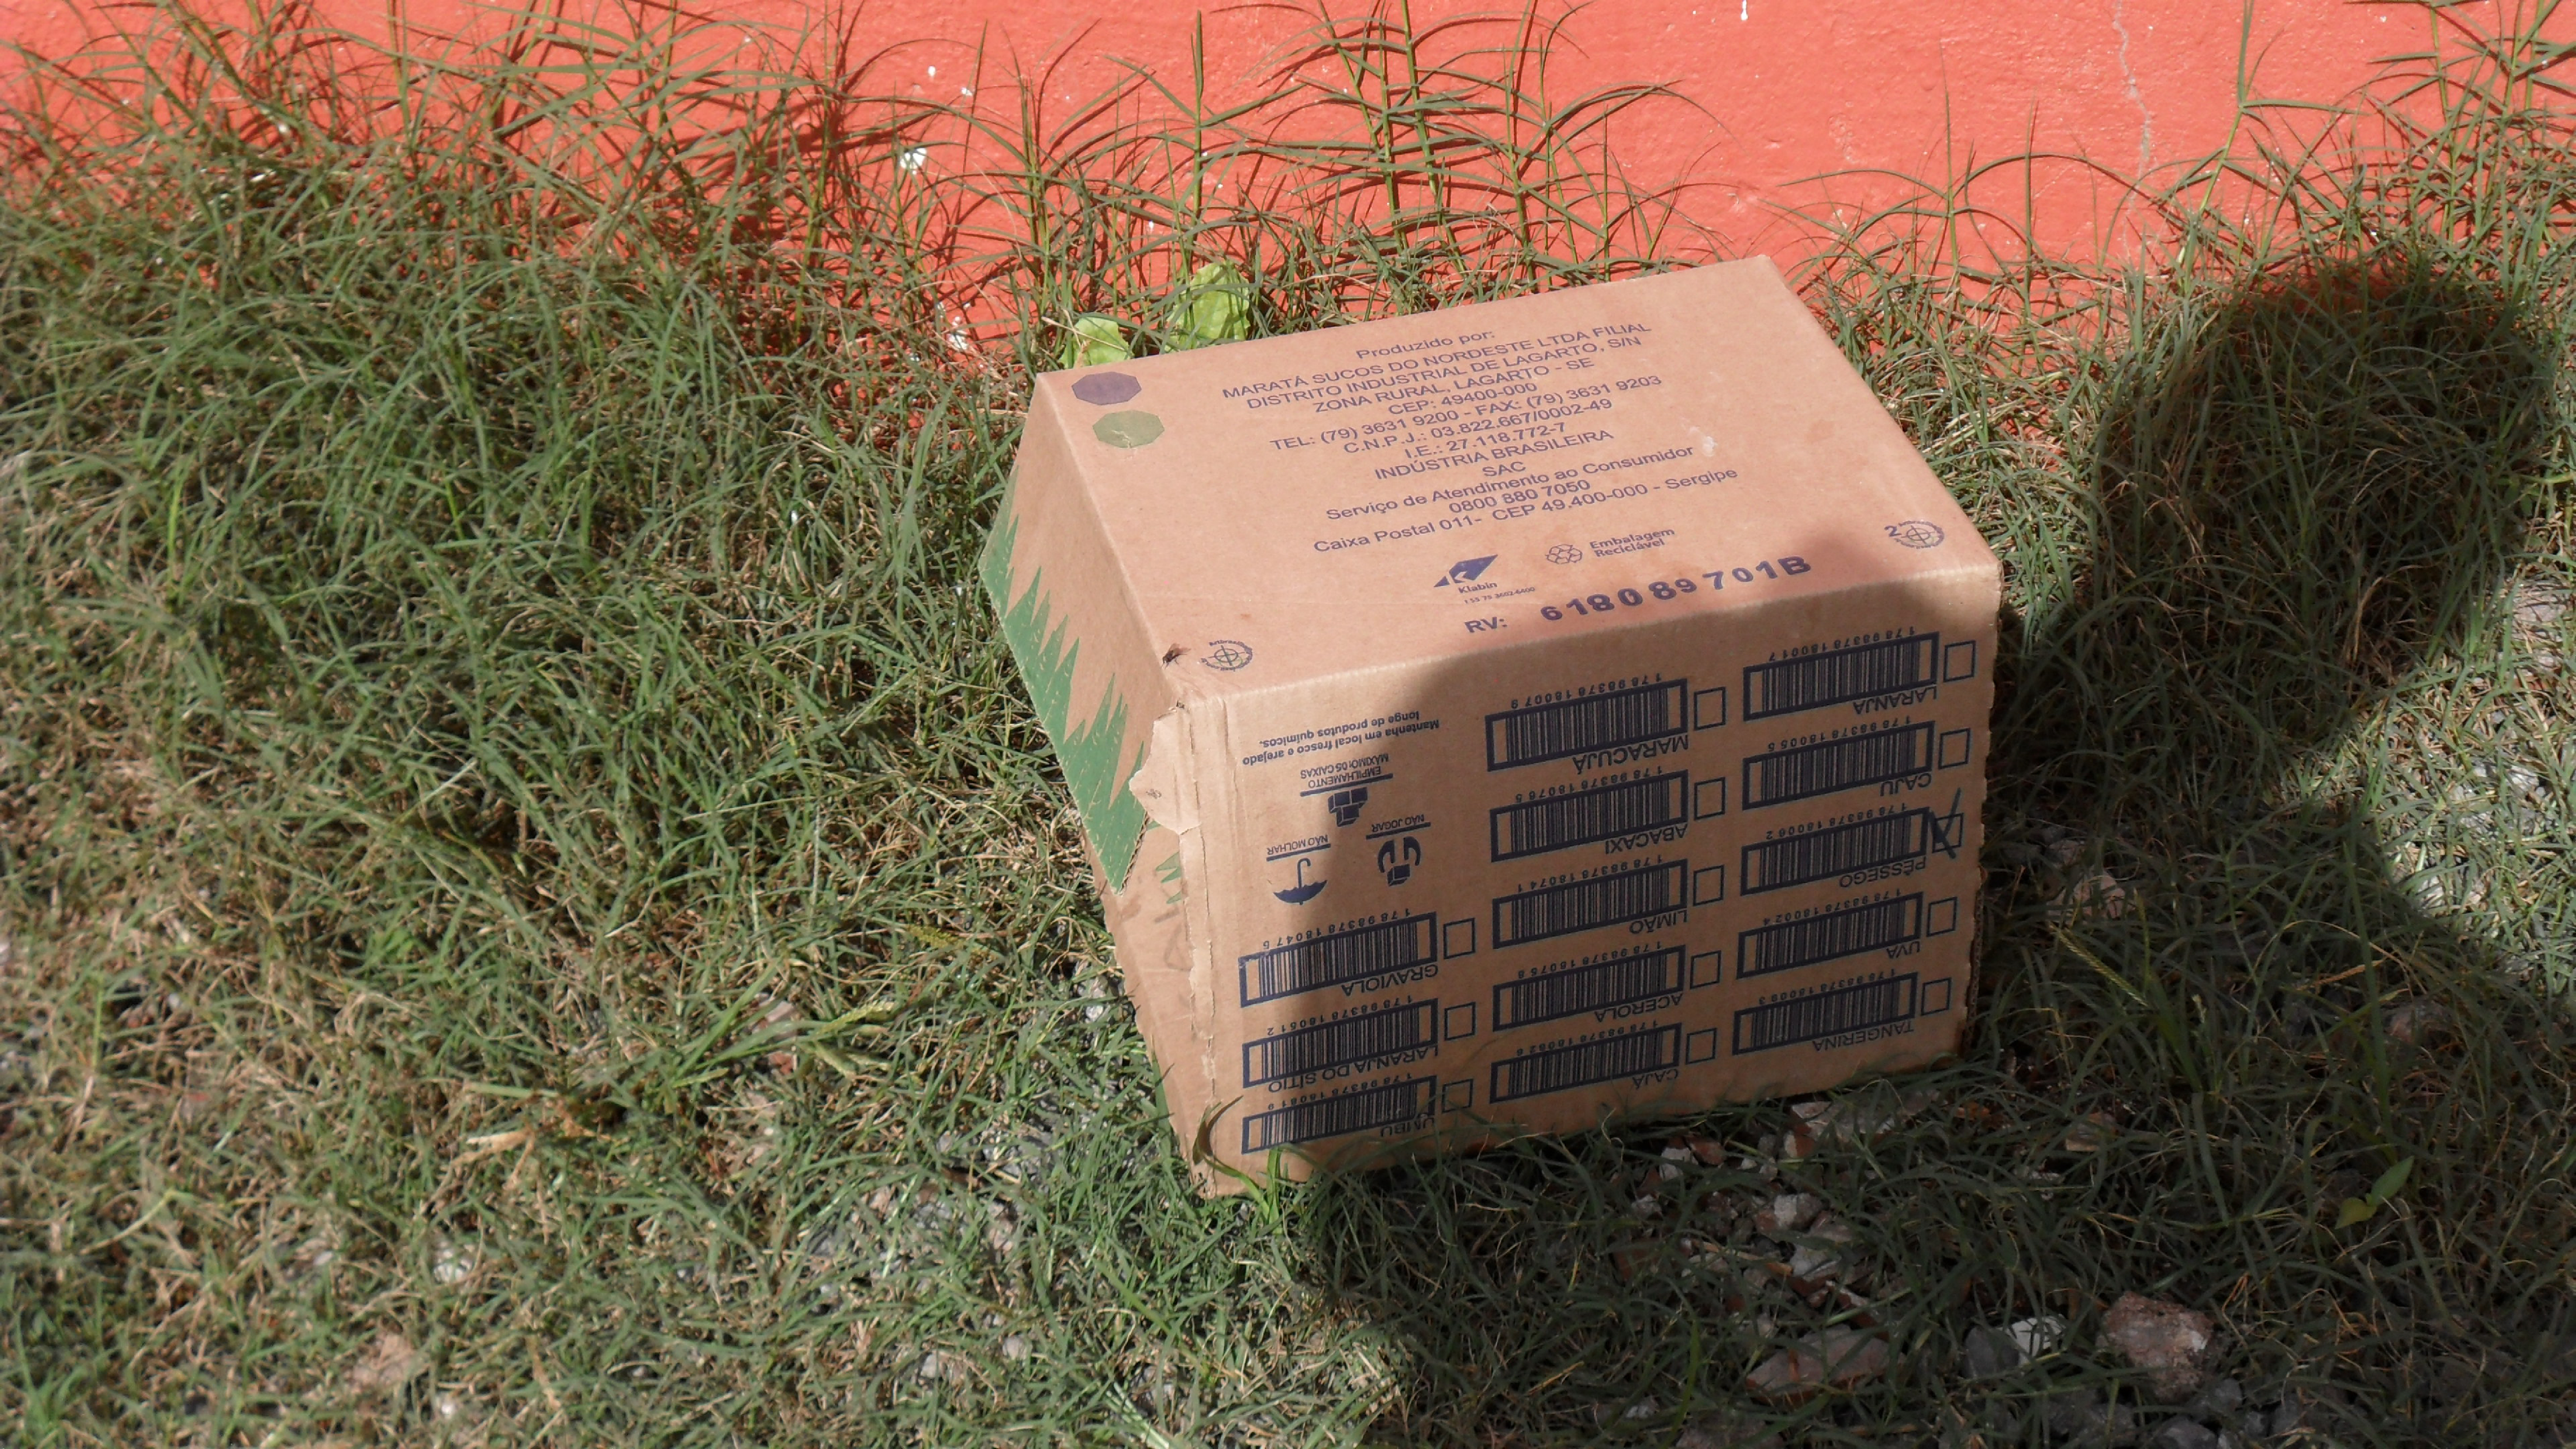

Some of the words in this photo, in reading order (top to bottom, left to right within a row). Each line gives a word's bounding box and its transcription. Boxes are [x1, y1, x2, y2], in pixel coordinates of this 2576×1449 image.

[1356, 337, 1453, 359] Produzido
[1459, 331, 1495, 345] por:
[1222, 376, 1309, 398] MARATÁ
[1312, 365, 1384, 384] SUCOS
[1389, 360, 1419, 372] DO
[1422, 340, 1534, 366] NORDESTE
[1537, 330, 1590, 348] LTDA
[1592, 323, 1652, 337] FILIAL
[1247, 386, 1341, 408] DISTRITO
[1346, 363, 1467, 393] INDUSTRIAL
[1470, 358, 1499, 372] DE
[1503, 344, 1604, 368] LAGARTO,
[1608, 337, 1642, 349] S/N
[1315, 395, 1372, 413] ZONA
[1375, 383, 1451, 403] RURAL,
[1453, 366, 1549, 389] LAGARTO
[1565, 358, 1594, 370] SE
[1388, 400, 1436, 415] CEP:
[1441, 383, 1537, 405] 49400-000
[1269, 436, 1315, 450] TEL:
[1321, 427, 1358, 443] (79)
[1362, 418, 1406, 435] 3631
[1412, 410, 1459, 426] 9200
[1475, 401, 1523, 415] FAX:
[1527, 393, 1563, 408] (79)
[1568, 384, 1611, 399] 3631
[1615, 376, 1662, 391] 9203
[1431, 399, 1612, 438] 03.822.667/0002-49
[1447, 423, 1565, 451] 27.118.772-7
[1375, 452, 1489, 479] INDÚSTRIA
[1491, 430, 1614, 459] BRASILEIRA
[1482, 461, 1526, 477] SAC
[1326, 501, 1398, 519] Serviço
[1403, 496, 1427, 506] de
[1433, 474, 1550, 502] Atendimento
[1555, 469, 1578, 480] ao
[1583, 447, 1694, 474] Consumidor
[1449, 497, 1497, 513] 0800
[1502, 489, 1538, 504] 880
[1543, 480, 1590, 497] 7050
[1314, 535, 1370, 552] Caixa
[1374, 522, 1435, 542] Postal
[1492, 504, 1535, 521] CEP
[1542, 484, 1648, 512] 49.400-000
[1664, 470, 1738, 489] Sergipe
[1590, 528, 1674, 549] Embalagem
[1884, 525, 1902, 537] 2
[1594, 538, 1665, 557] Reciclável
[1458, 583, 1497, 593] Klabin
[1465, 617, 1508, 633] RV:
[1853, 686, 1937, 715] LARANJA
[1371, 718, 1385, 727] de
[1388, 711, 1420, 723] longe
[1259, 730, 1314, 747] químicos.
[1317, 719, 1368, 738] produtos
[1365, 731, 1382, 740] em
[1385, 720, 1439, 737] Mantenha
[1297, 742, 1332, 754] fresco
[1335, 734, 1362, 748] local
[1242, 750, 1284, 766] arejado
[1349, 754, 1388, 767] MÁXIMO:
[1572, 735, 1689, 774] MARACUJÁ
[1300, 765, 1334, 778] CAIXAS
[1308, 767, 1381, 788] EMPILHAMENTO
[1880, 773, 1932, 796] CAJU
[1371, 818, 1403, 832] JOGAR
[1405, 815, 1424, 825] NÃO
[1266, 839, 1306, 855] MOLHAR
[1308, 835, 1328, 846] NÃO
[1605, 824, 1687, 854] ABACAXI
[1839, 856, 1926, 887] PÊSSEGO
[1629, 910, 1687, 934] LIMÃO
[1886, 941, 1920, 959] UVA
[1341, 965, 1438, 996] GRAVIOLA
[1594, 993, 1683, 1022] ACEROLA
[1813, 1020, 1914, 1051] TANGERINA
[1354, 1046, 1438, 1073] LARANJA
[1268, 1072, 1316, 1092] SÍTIO
[1322, 1064, 1350, 1080] DO
[1632, 1069, 1678, 1089] CAJÁ
[1380, 1117, 1435, 1137] UMBU
